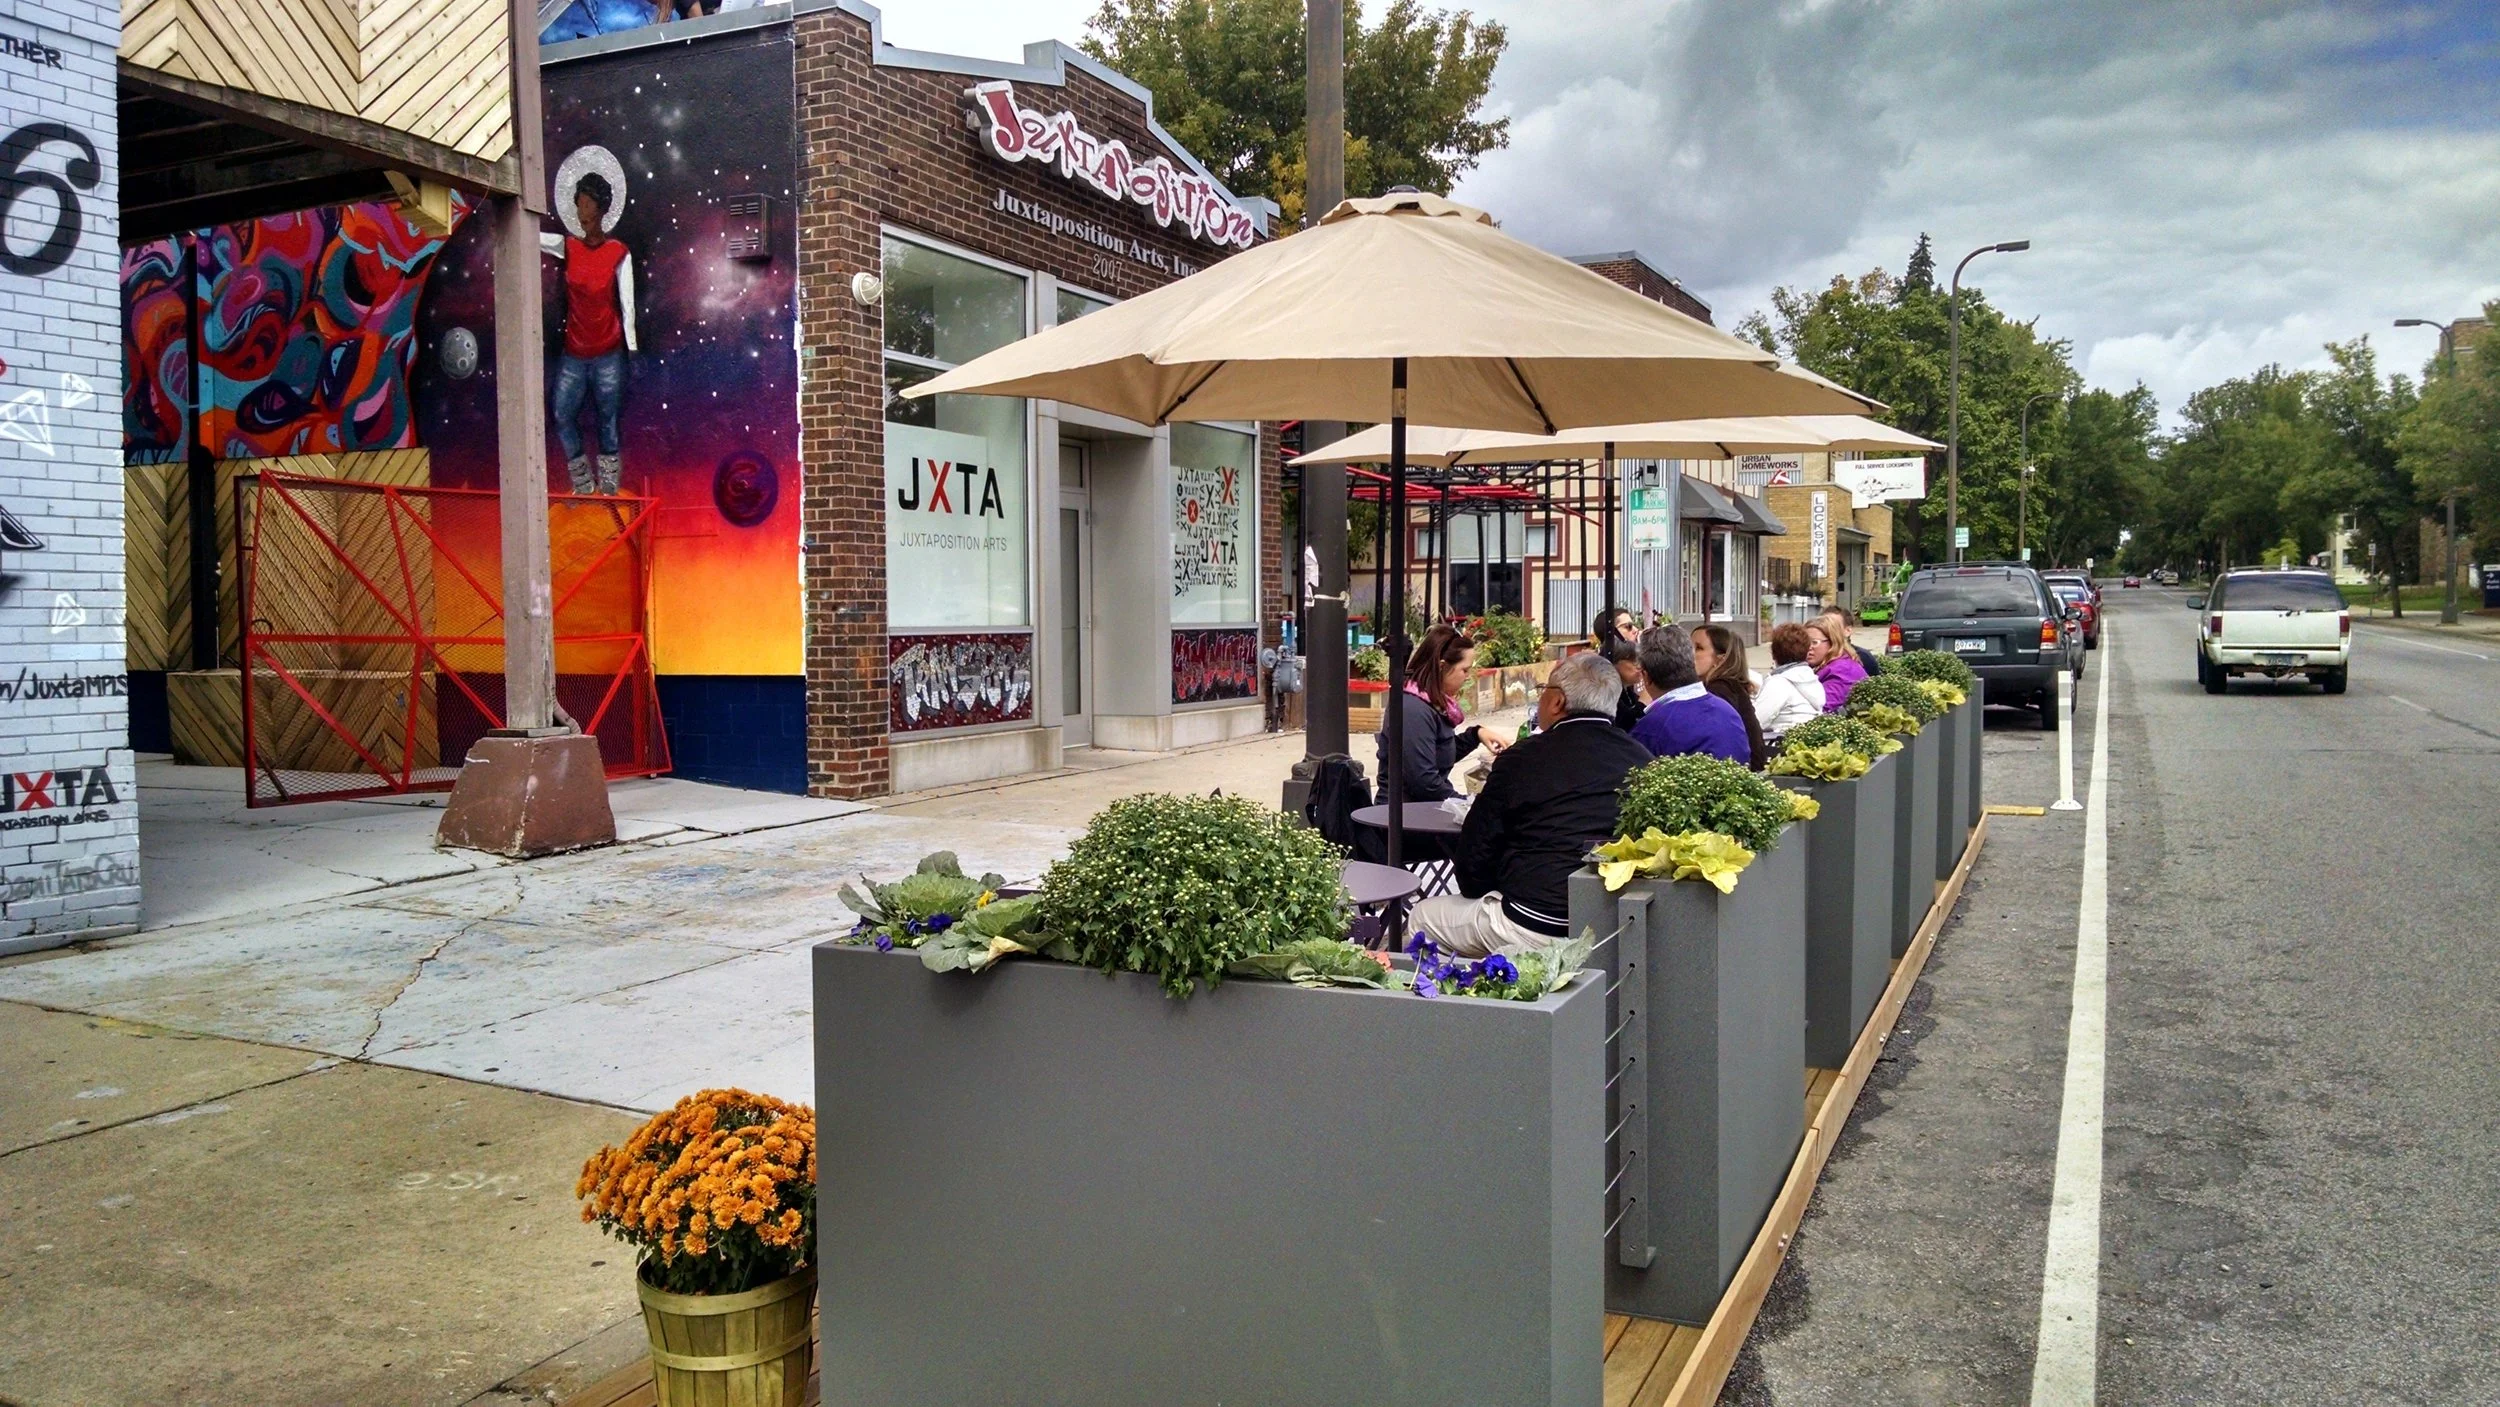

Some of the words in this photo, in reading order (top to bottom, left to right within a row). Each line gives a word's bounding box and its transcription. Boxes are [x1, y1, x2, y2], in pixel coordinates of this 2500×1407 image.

[993, 188, 1124, 255] Juxtaposition
[1128, 238, 1169, 275] Arts,
[1092, 253, 1122, 282] 2007
[1741, 455, 1772, 463] URBAN
[1741, 461, 1799, 470] HOMEWORKS
[898, 456, 1005, 519] JXTA
[899, 532, 980, 550] JUXTAPOSITION
[983, 537, 1007, 551] ARTS
[1813, 496, 1825, 573] LOCKSMITH
[1201, 540, 1238, 565] JXTA
